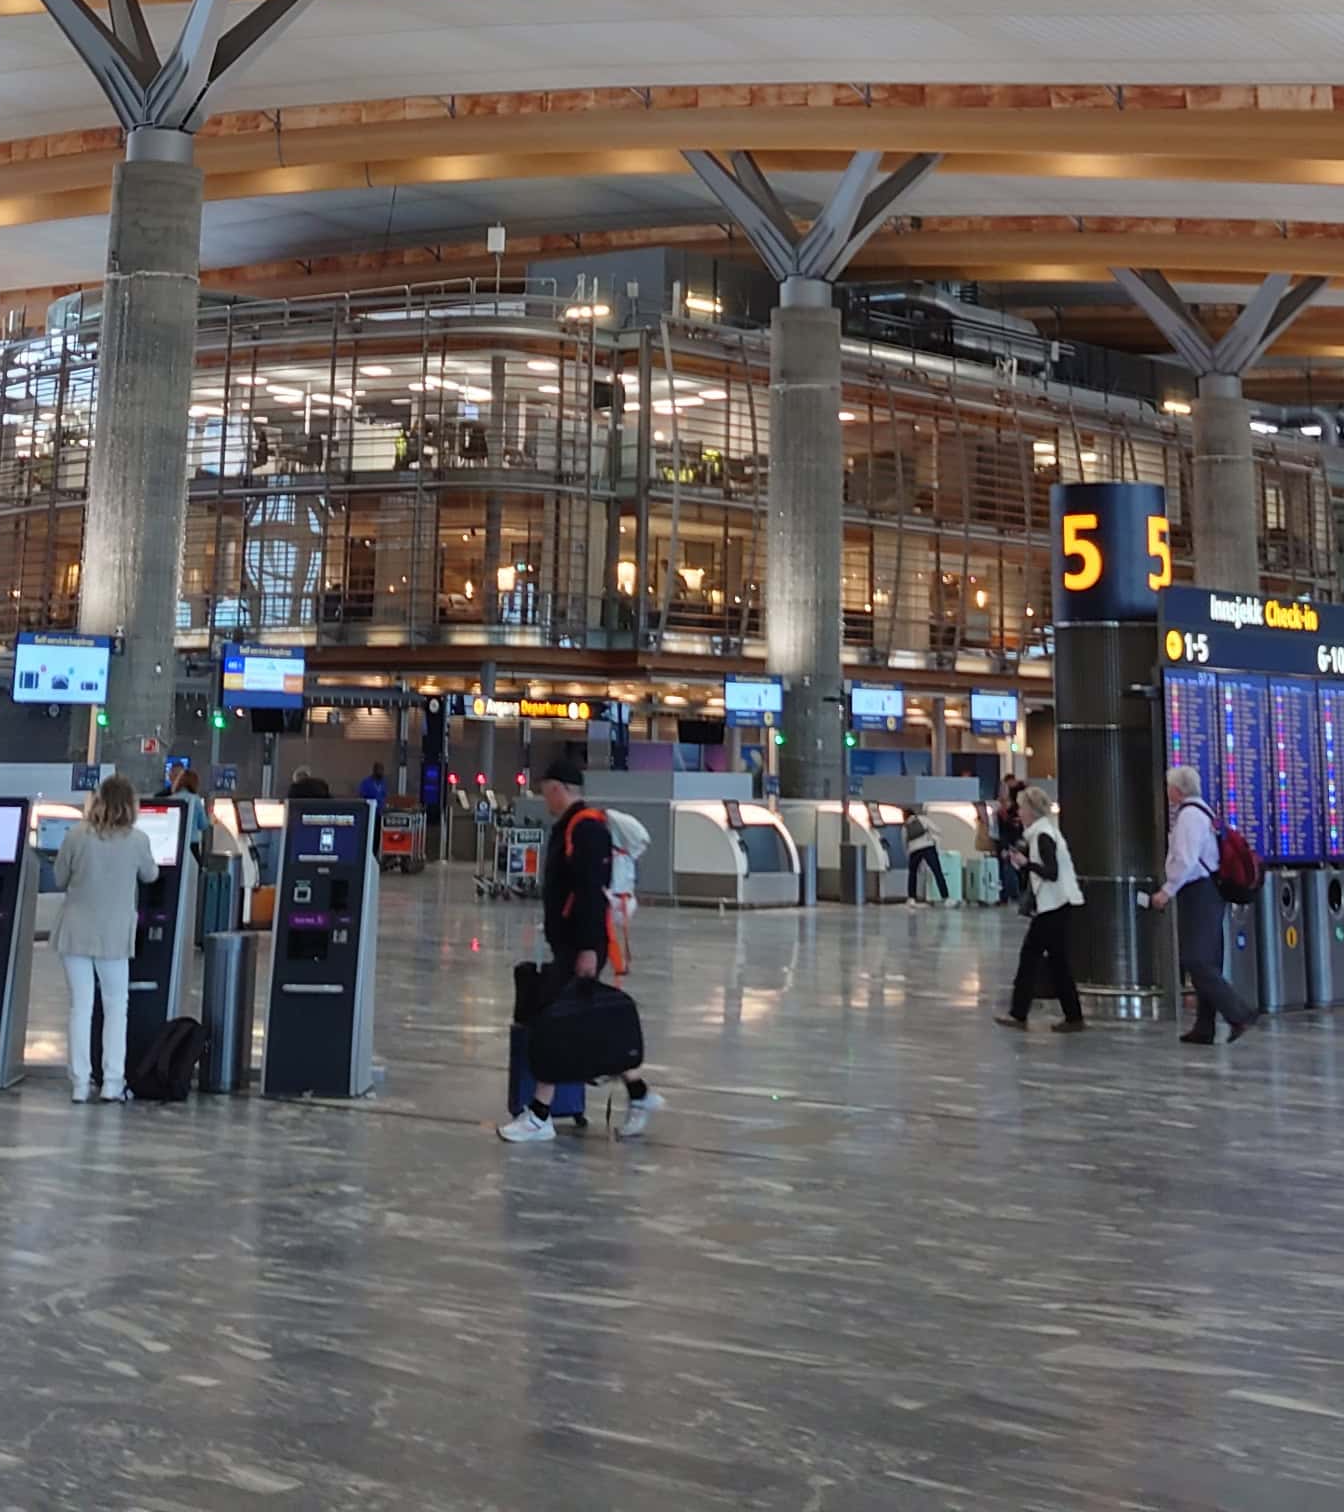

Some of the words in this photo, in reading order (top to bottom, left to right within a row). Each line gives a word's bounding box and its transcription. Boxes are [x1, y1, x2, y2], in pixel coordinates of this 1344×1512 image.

[1062, 513, 1104, 591] 5
[1147, 515, 1172, 591] 5
[1209, 594, 1264, 630] Innsjekk
[1264, 600, 1319, 631] Check-in
[1184, 632, 1210, 663] 1-5
[486, 698, 520, 719] Avgang
[520, 699, 568, 717] Departures
